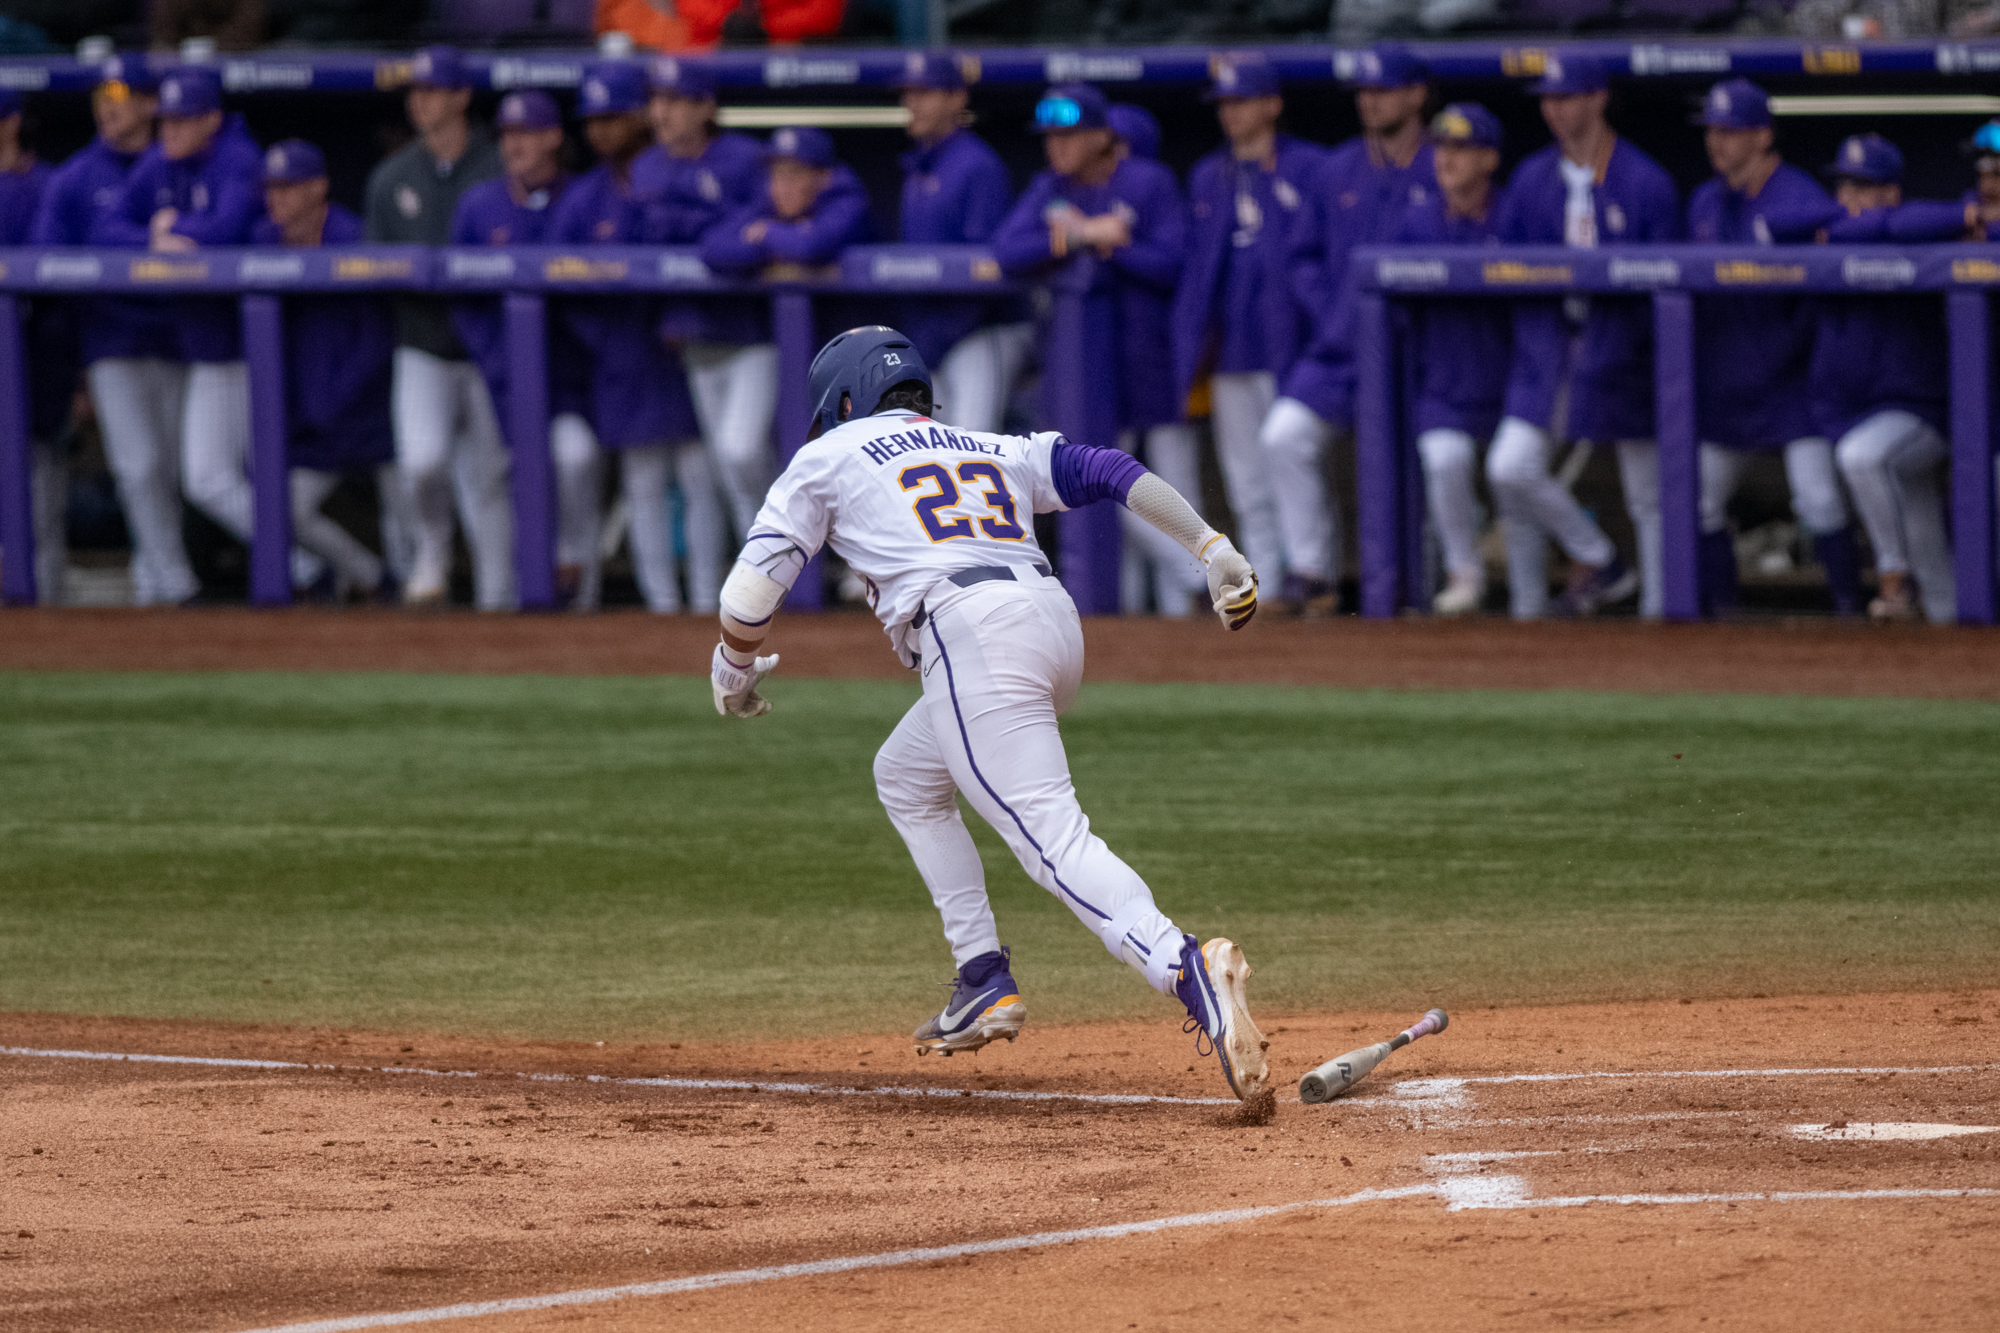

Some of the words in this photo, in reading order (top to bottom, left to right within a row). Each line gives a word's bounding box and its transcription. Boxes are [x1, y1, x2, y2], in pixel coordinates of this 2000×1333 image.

[883, 352, 902, 366] 23
[860, 426, 1006, 466] HERNANDEZ
[897, 460, 1027, 544] 23
